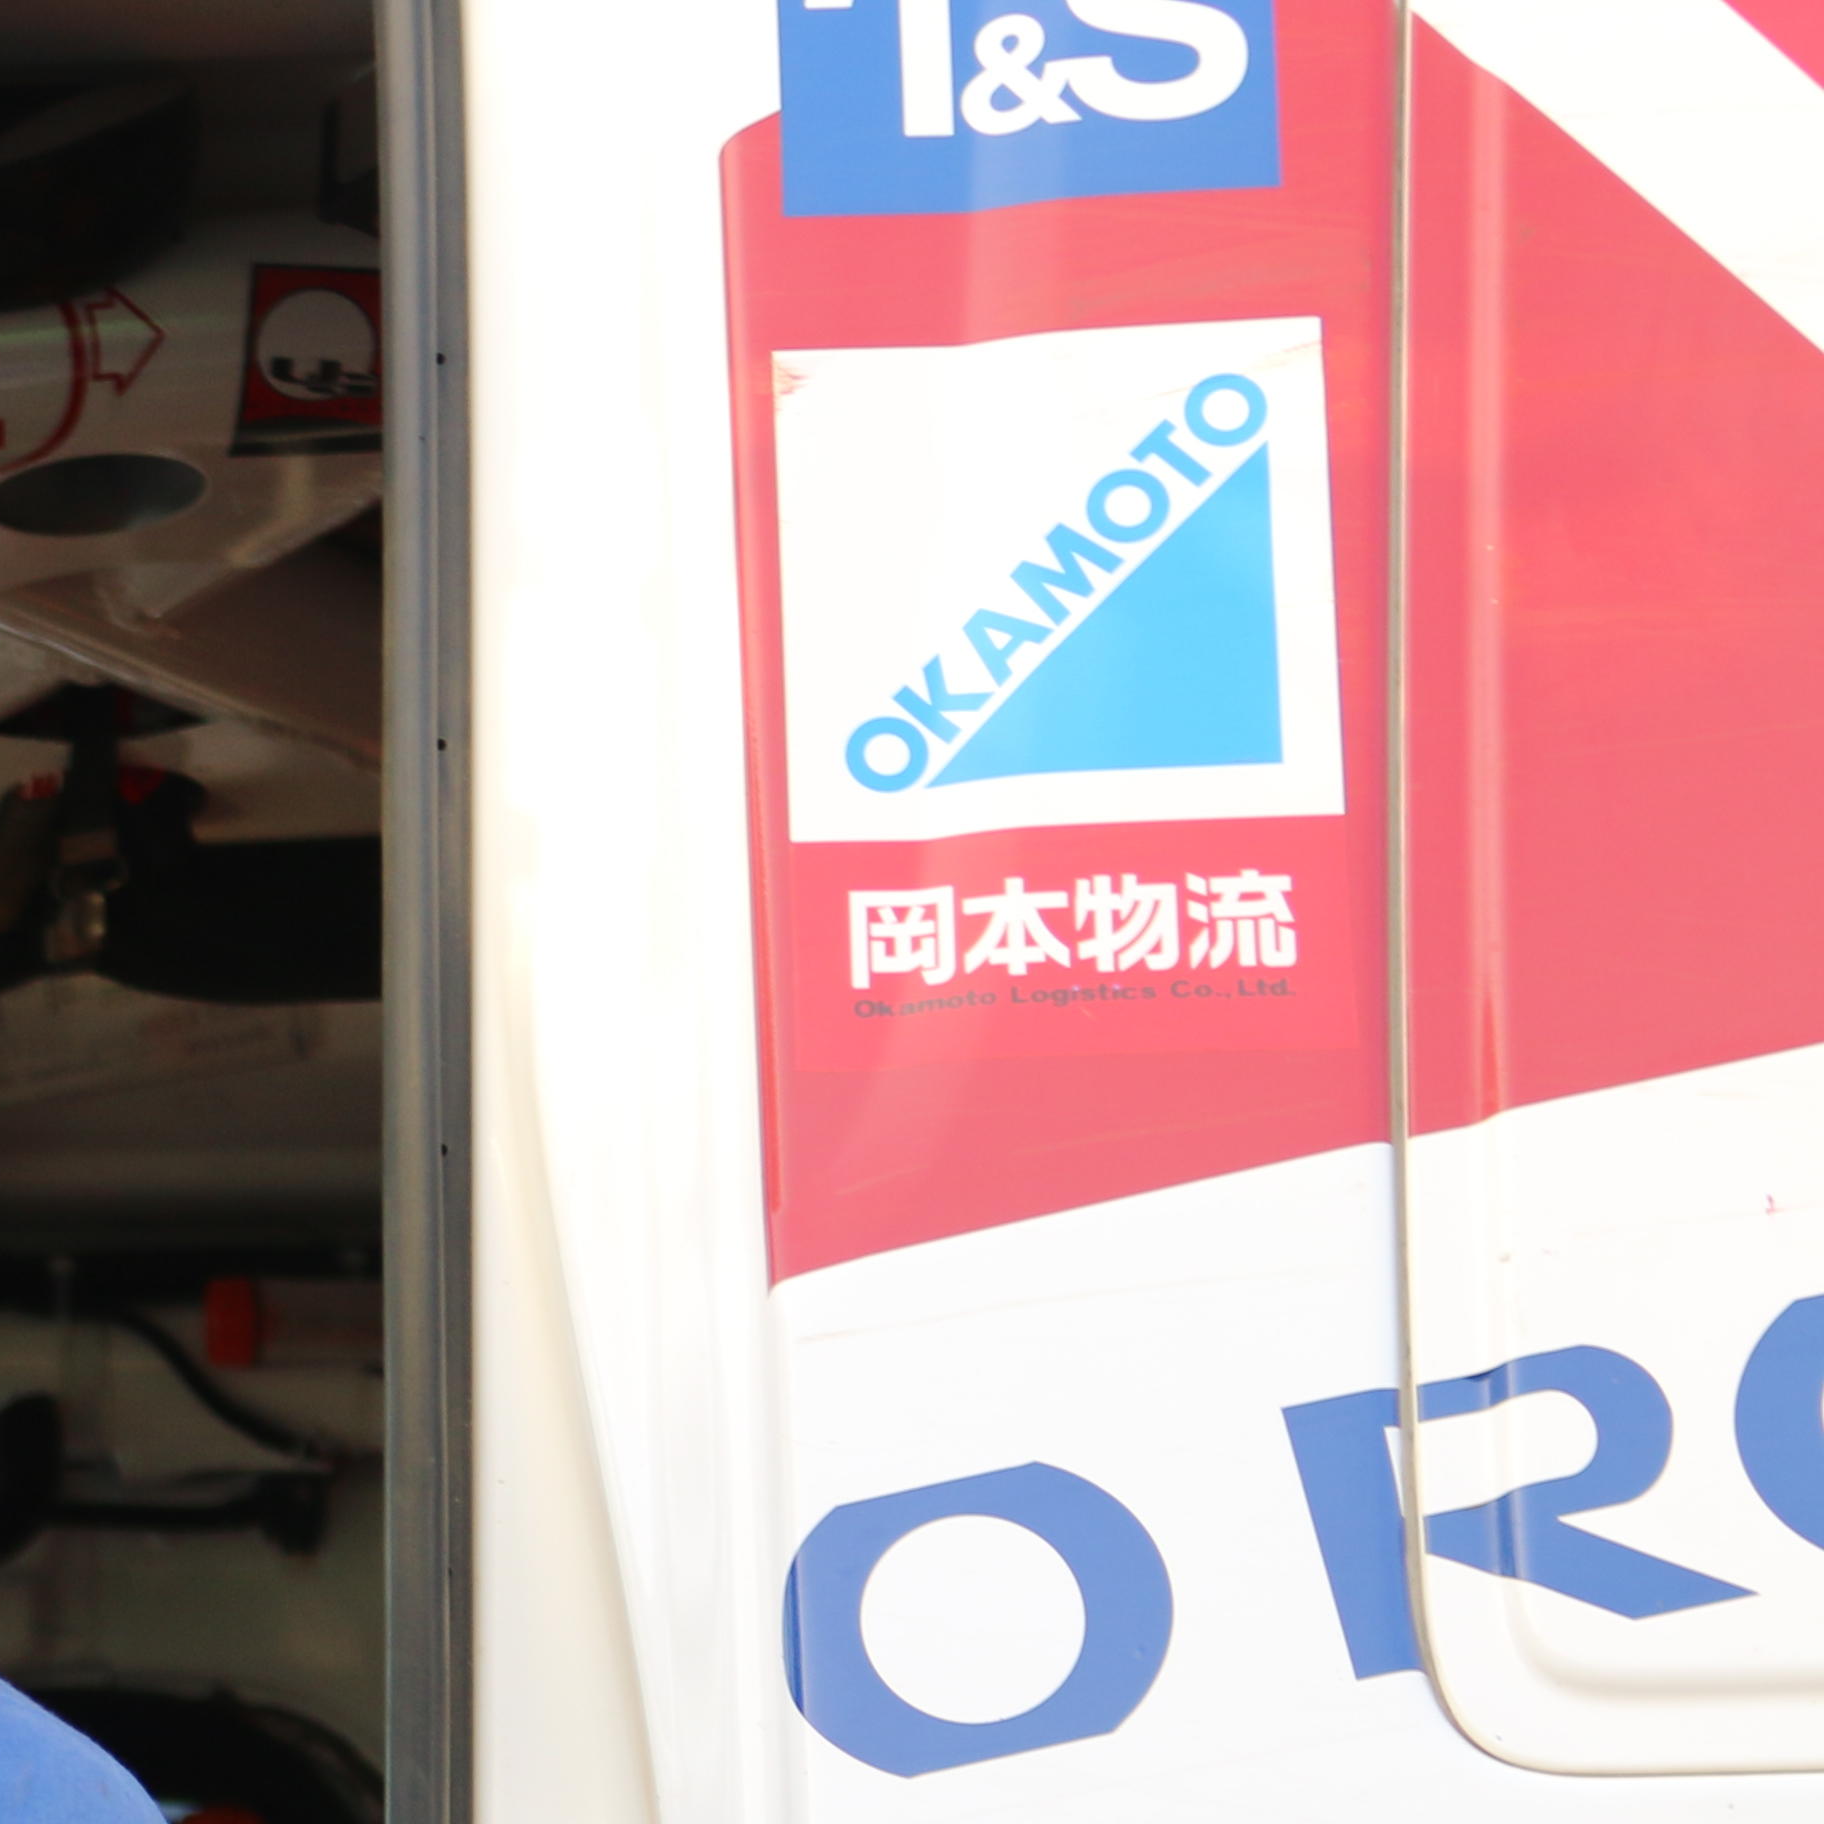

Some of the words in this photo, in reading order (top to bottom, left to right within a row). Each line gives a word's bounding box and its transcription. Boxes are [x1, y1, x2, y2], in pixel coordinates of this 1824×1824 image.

[844, 372, 1268, 793] OKAMOTO
[846, 867, 1299, 991] 岡本物流
[854, 988, 997, 1020] Okamoto
[1010, 983, 1158, 1008] Logistics
[781, 1292, 1824, 1780] OR
